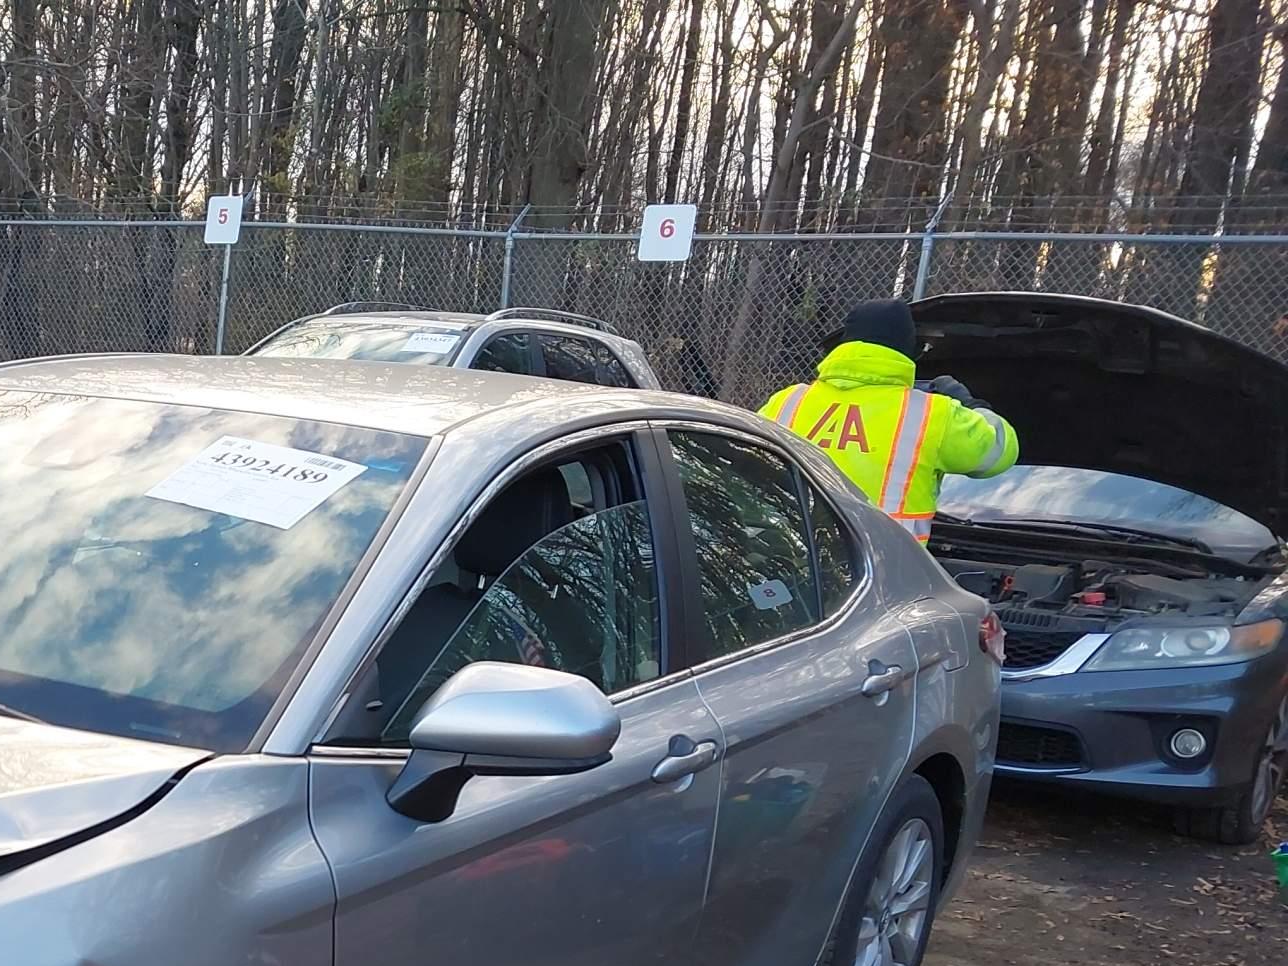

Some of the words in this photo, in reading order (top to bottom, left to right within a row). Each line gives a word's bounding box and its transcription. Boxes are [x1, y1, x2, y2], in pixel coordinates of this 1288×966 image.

[218, 208, 229, 225] 5
[659, 218, 676, 239] 6
[210, 452, 328, 483] 43924189
